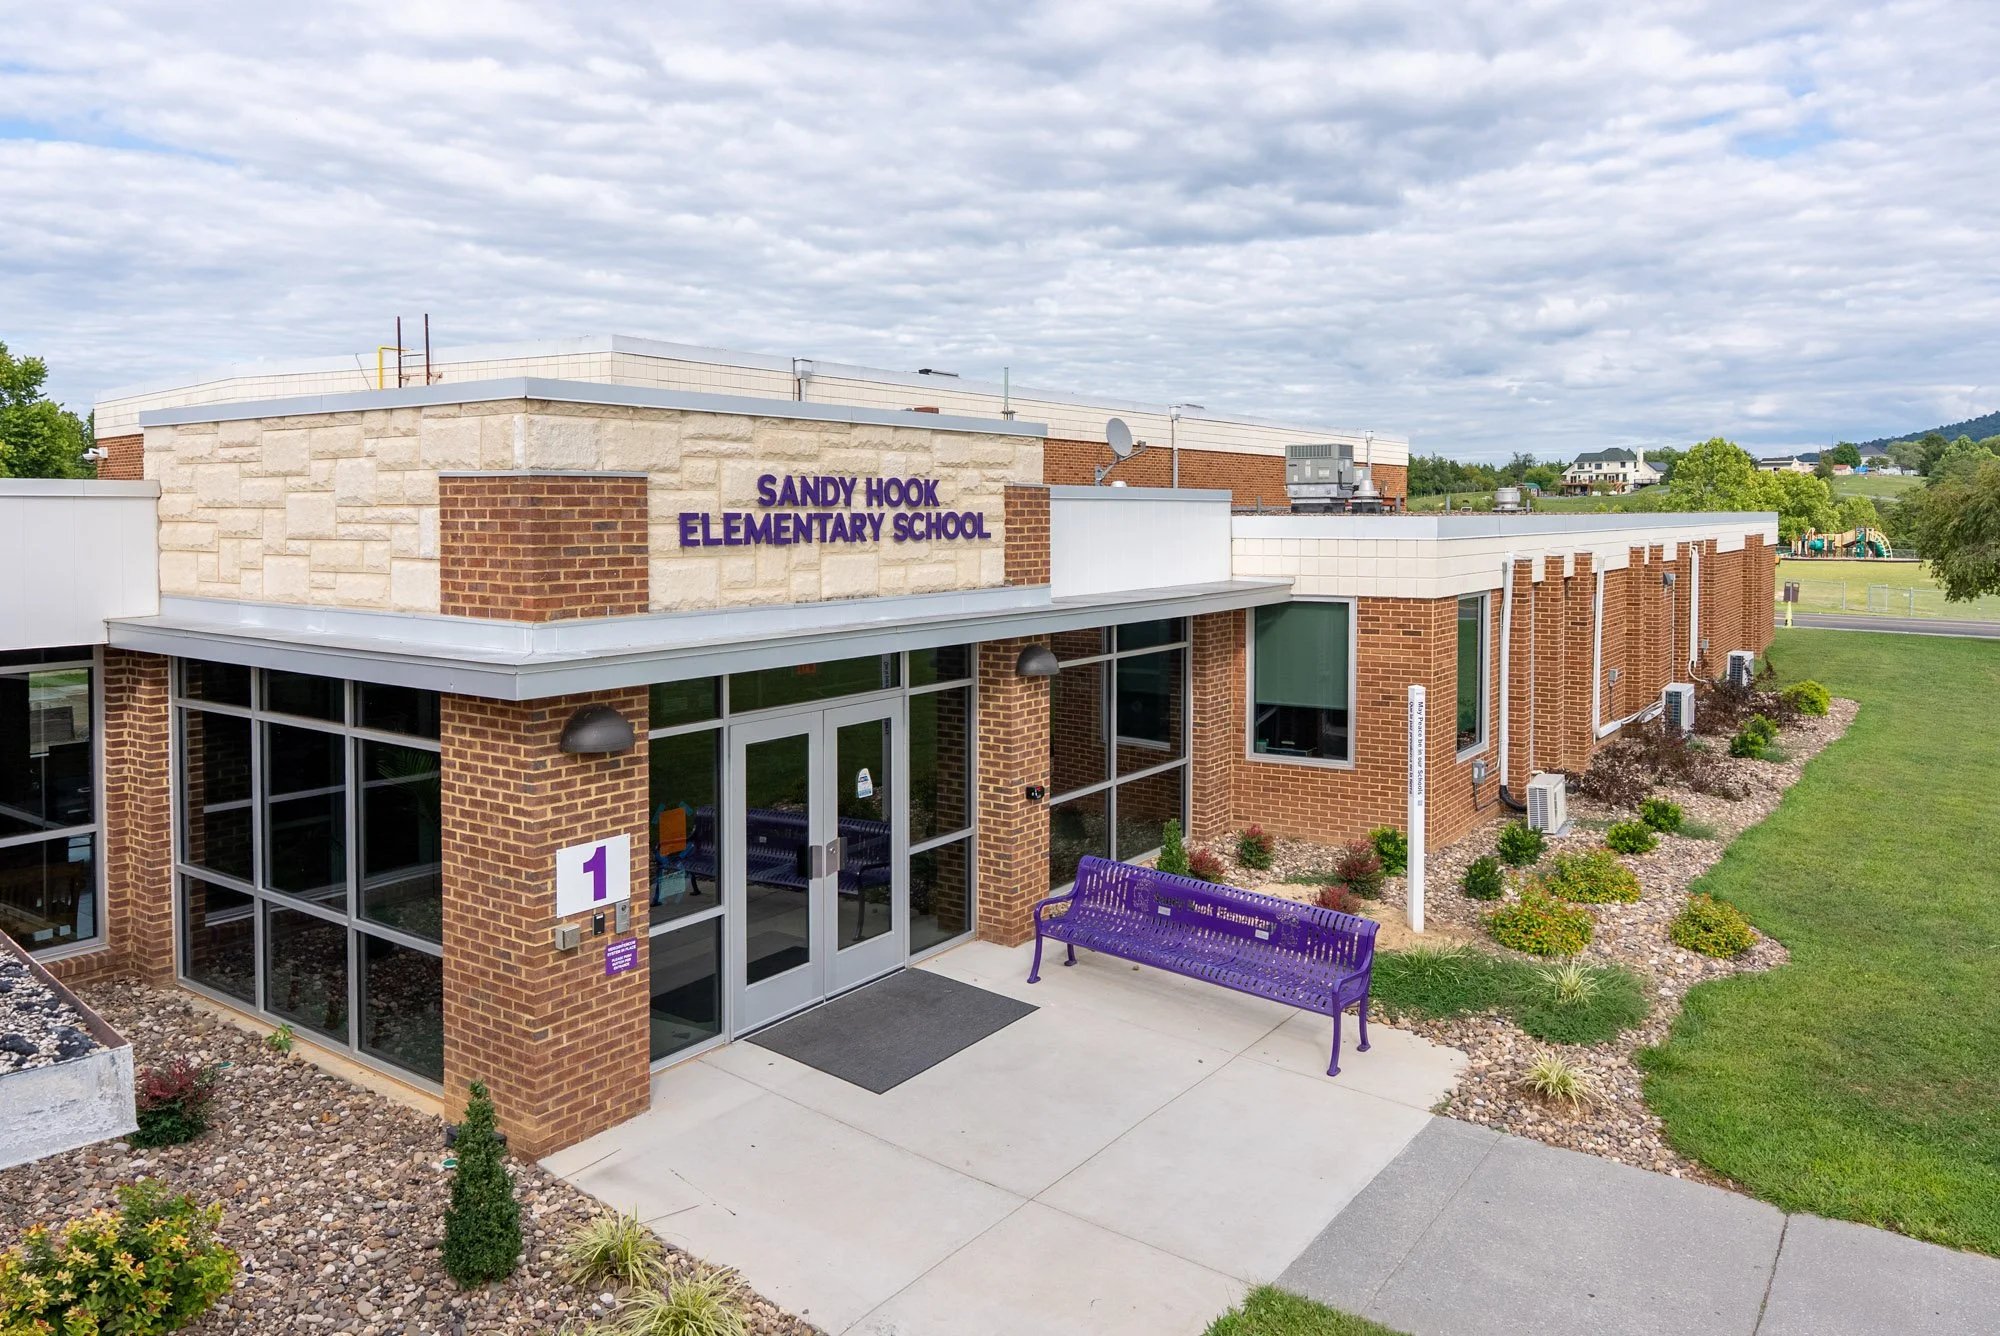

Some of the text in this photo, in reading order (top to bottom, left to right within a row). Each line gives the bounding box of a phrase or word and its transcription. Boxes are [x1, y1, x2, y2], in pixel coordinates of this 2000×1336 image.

[757, 474, 940, 507] SANDY HOOK
[679, 511, 991, 547] ELEMENTARY SCHOOL
[1418, 739, 1423, 748] be
[583, 845, 607, 901] 1
[1187, 899, 1214, 916] Hook
[1216, 905, 1277, 935] Elementary
